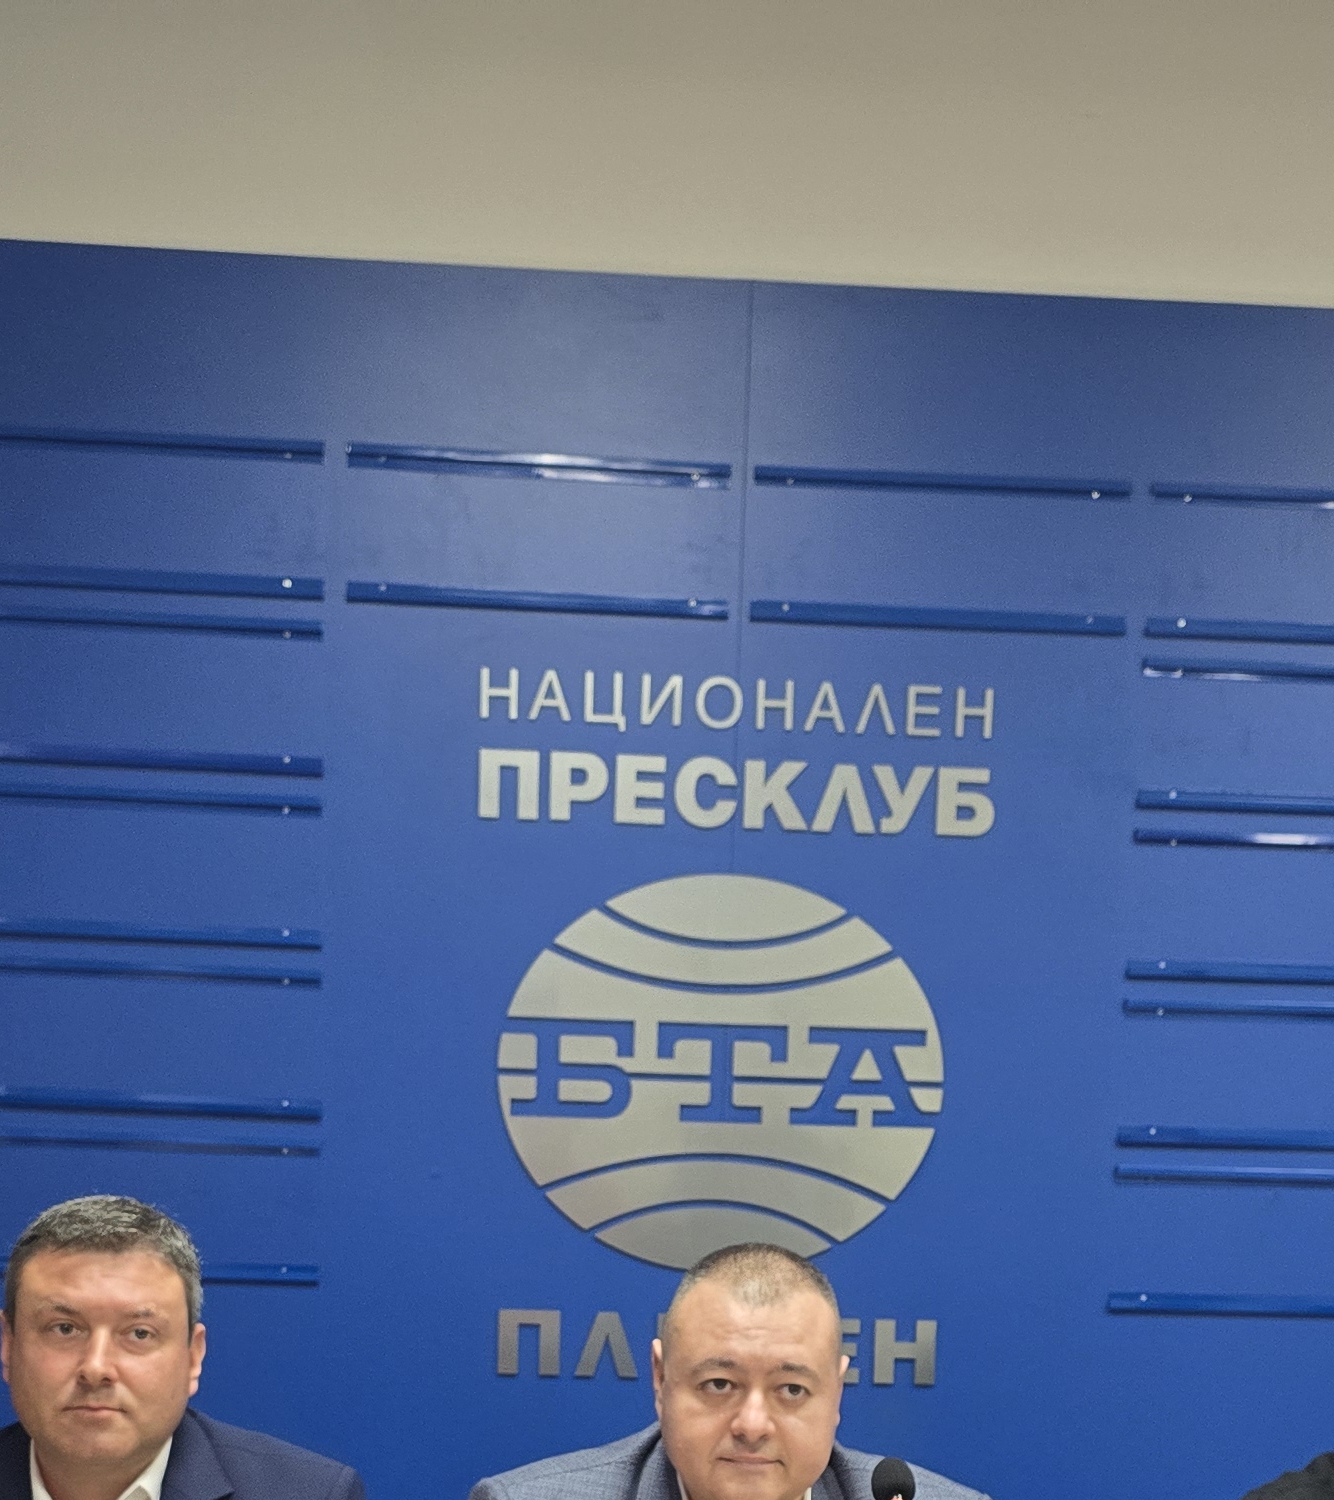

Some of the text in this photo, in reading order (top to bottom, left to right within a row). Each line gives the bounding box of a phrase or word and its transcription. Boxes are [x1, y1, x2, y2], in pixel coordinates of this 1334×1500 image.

[479, 667, 995, 739] НАЦИОНАЛЕН
[477, 748, 996, 837] ПРЕСКЛУБ
[510, 1015, 941, 1127] БТА
